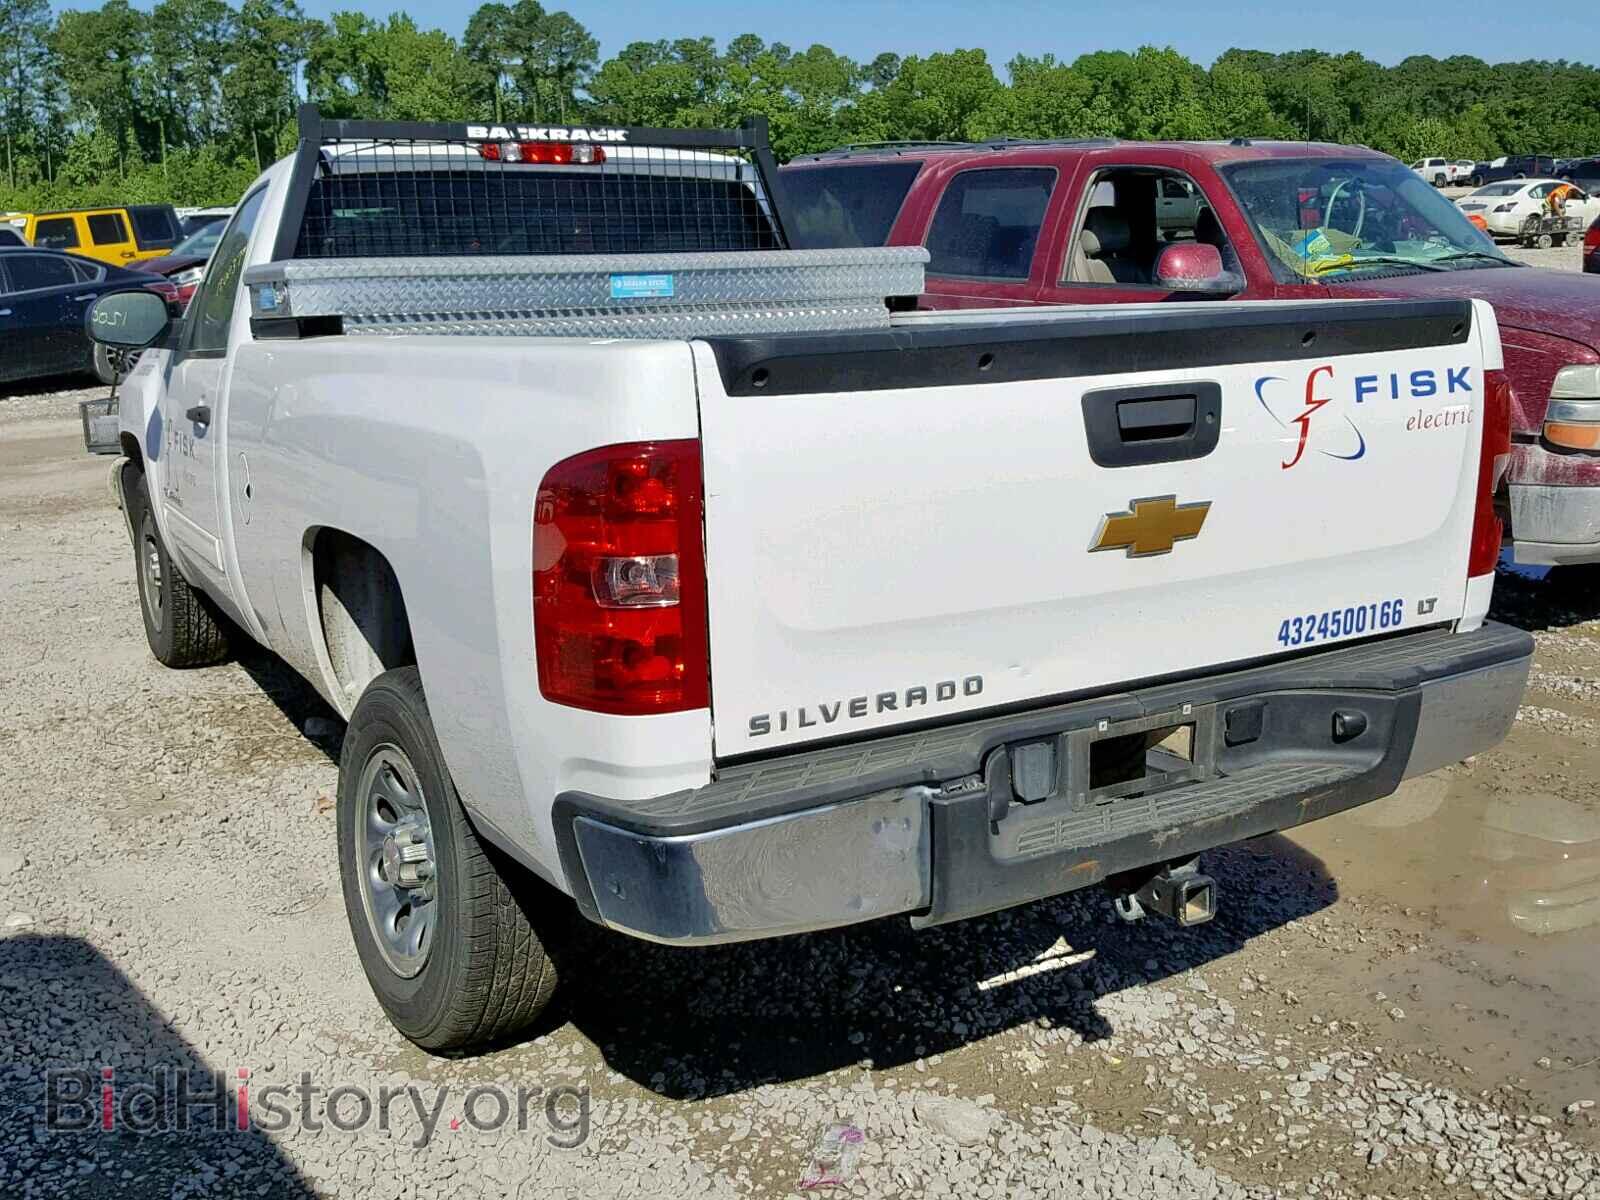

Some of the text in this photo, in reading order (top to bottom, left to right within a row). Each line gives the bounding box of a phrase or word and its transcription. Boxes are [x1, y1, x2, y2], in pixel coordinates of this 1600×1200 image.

[1355, 366, 1473, 404] FISK
[1406, 403, 1475, 432] electric
[1278, 598, 1403, 646] 4324500166
[1417, 597, 1438, 616] LT
[748, 674, 984, 737] SILVERADO
